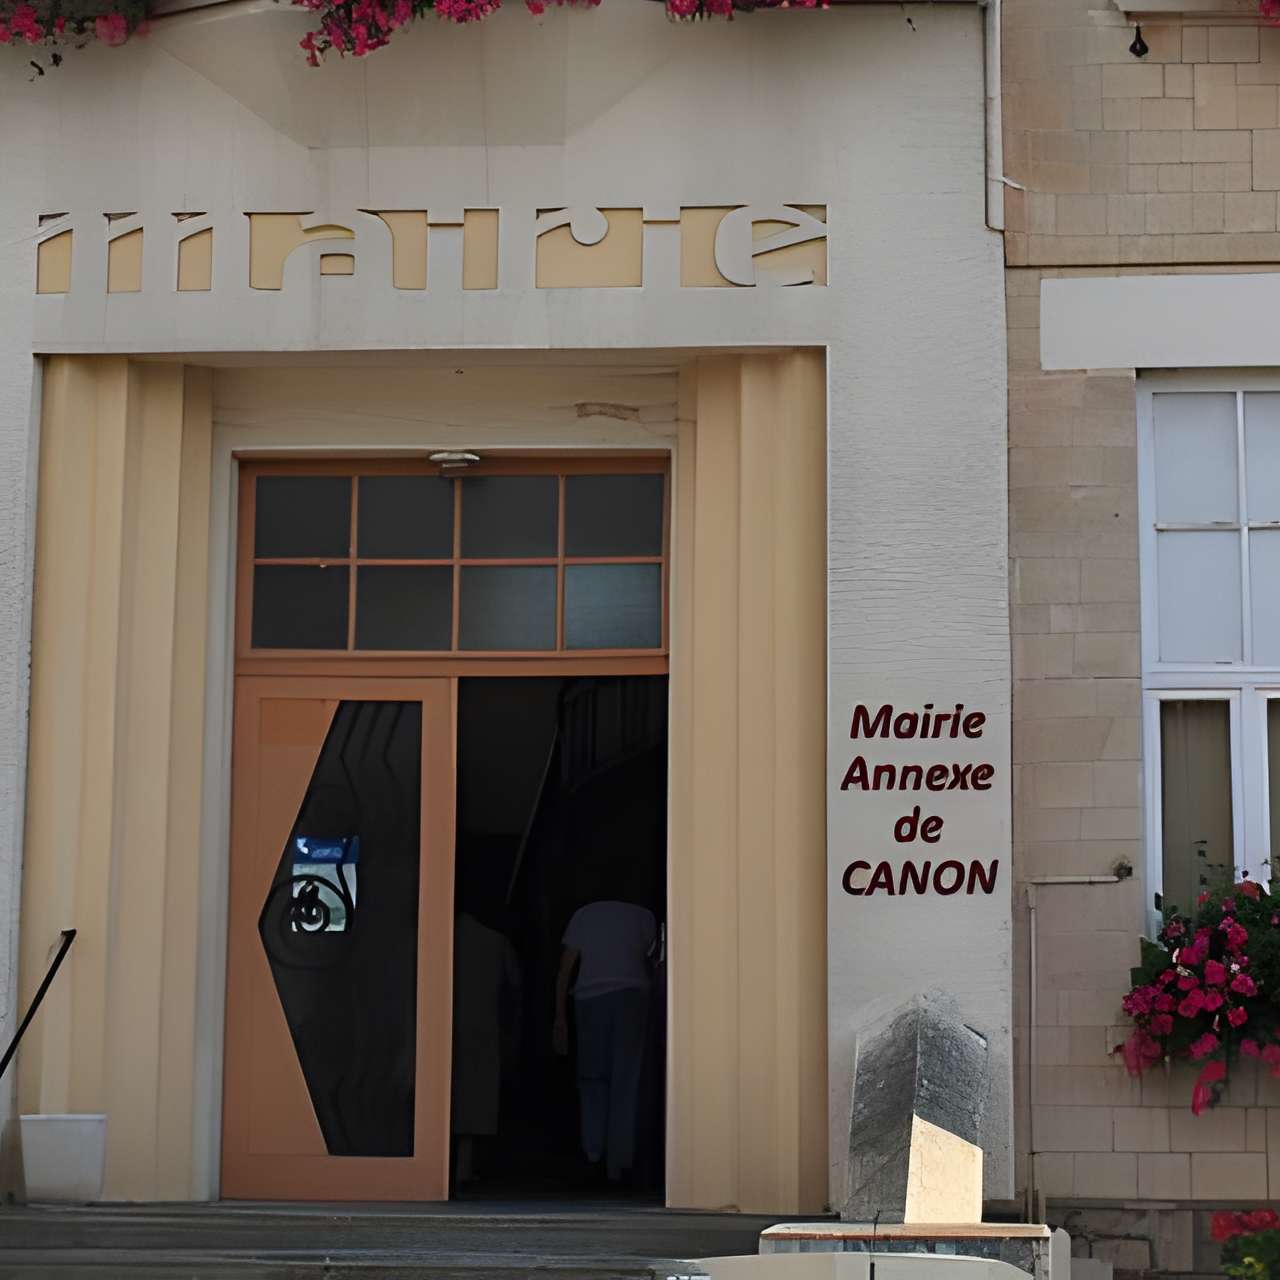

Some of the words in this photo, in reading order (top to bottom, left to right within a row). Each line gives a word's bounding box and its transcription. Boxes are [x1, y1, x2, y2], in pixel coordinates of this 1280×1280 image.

[850, 703, 986, 739] Mairie
[840, 755, 995, 791] Annexe
[893, 805, 944, 843] de
[841, 859, 999, 896] CANON
